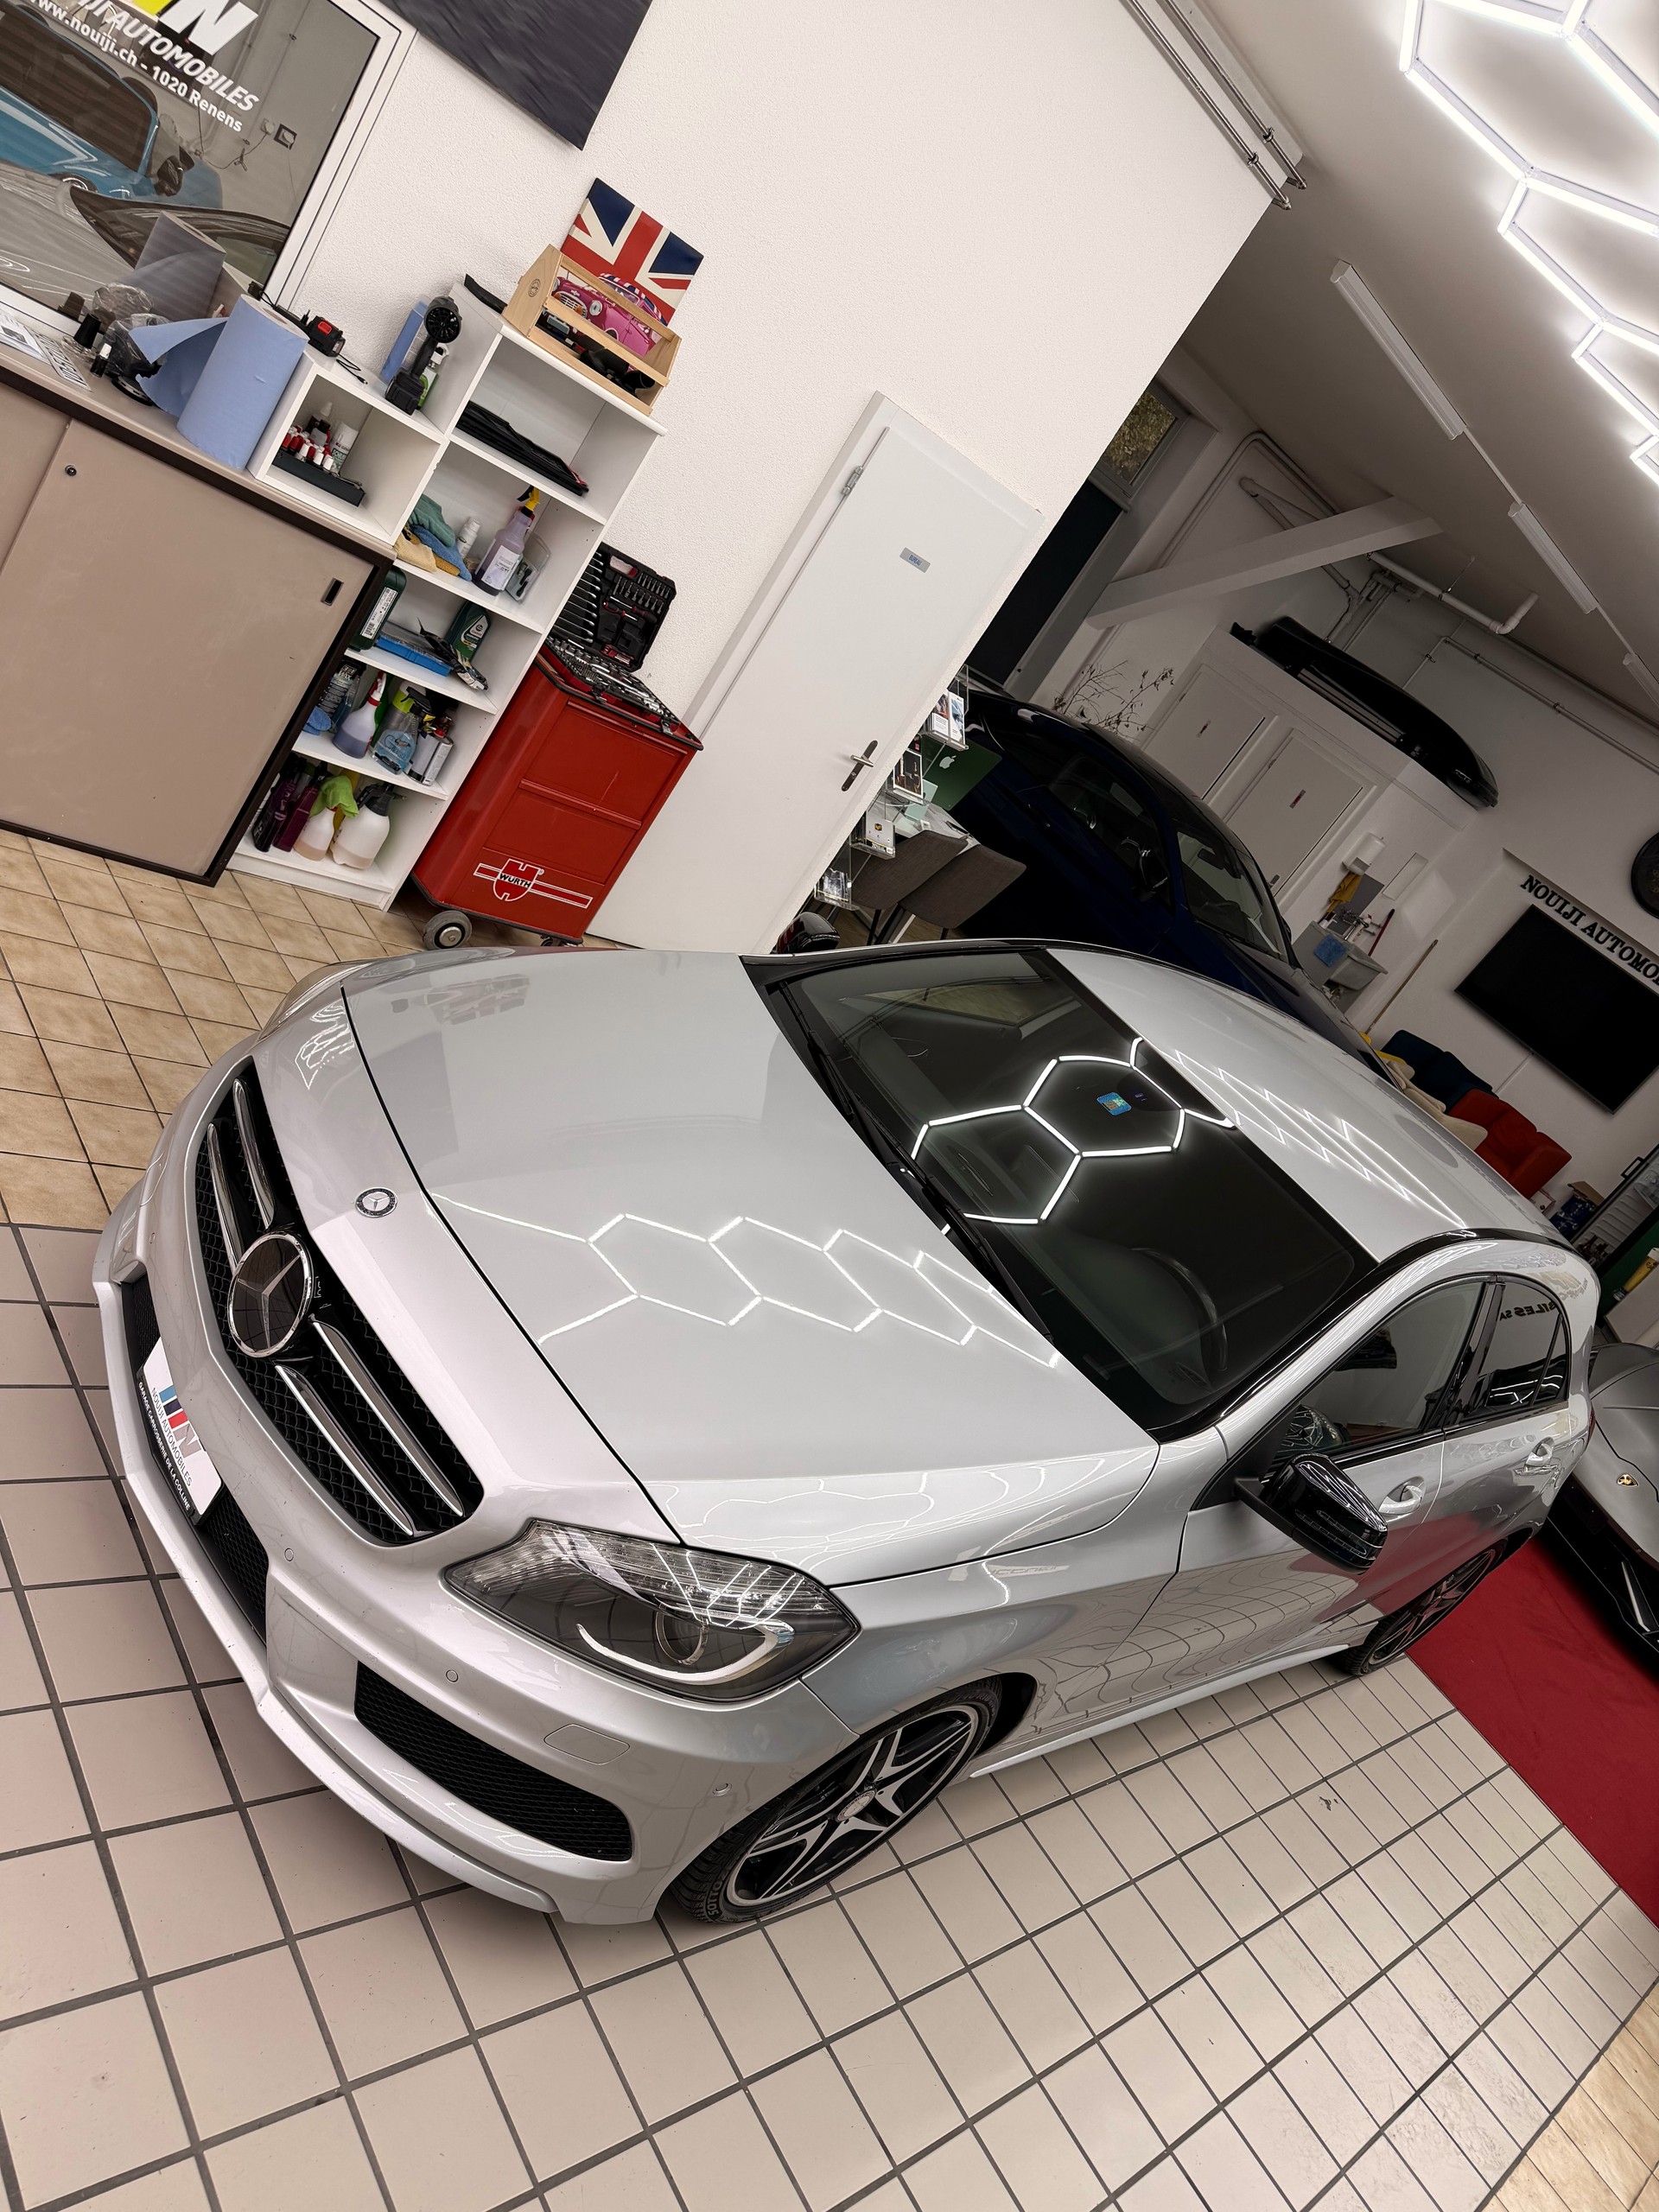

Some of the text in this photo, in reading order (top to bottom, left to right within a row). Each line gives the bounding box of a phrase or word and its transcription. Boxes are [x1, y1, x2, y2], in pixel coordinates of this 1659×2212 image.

[30, 0, 138, 67] ww.nouiji.ch
[152, 66, 188, 97] 1020
[188, 88, 243, 132] Renens
[104, 10, 259, 111] AUTOMOBILES
[1520, 874, 1586, 927] NOUIJI
[162, 1419, 192, 1487] AUTOMOBILES
[165, 1458, 173, 1470] DE
[170, 1468, 176, 1480] LA
[175, 1478, 191, 1511] COLLINE
